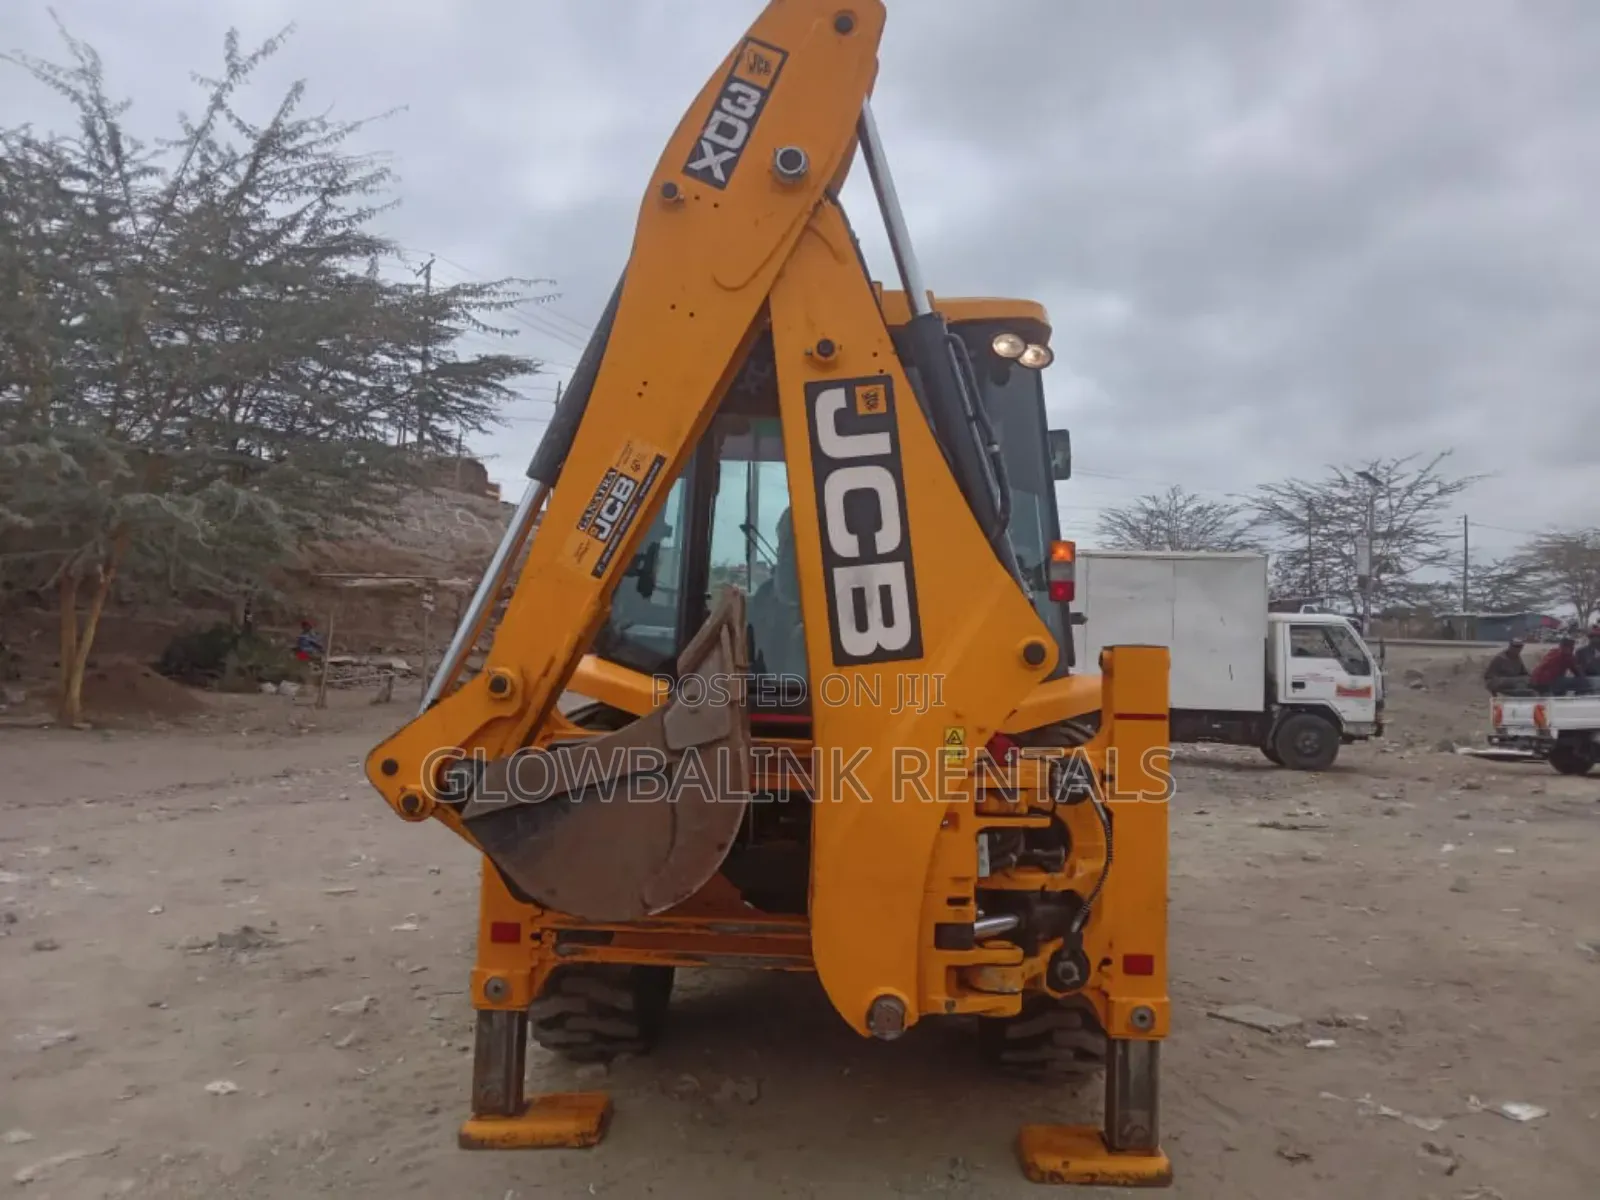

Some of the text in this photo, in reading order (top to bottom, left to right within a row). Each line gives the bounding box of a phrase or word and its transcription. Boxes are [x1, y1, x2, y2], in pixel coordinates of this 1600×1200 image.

[687, 82, 761, 182] 3DX
[594, 476, 635, 540] JCB
[815, 387, 912, 657] JCB
